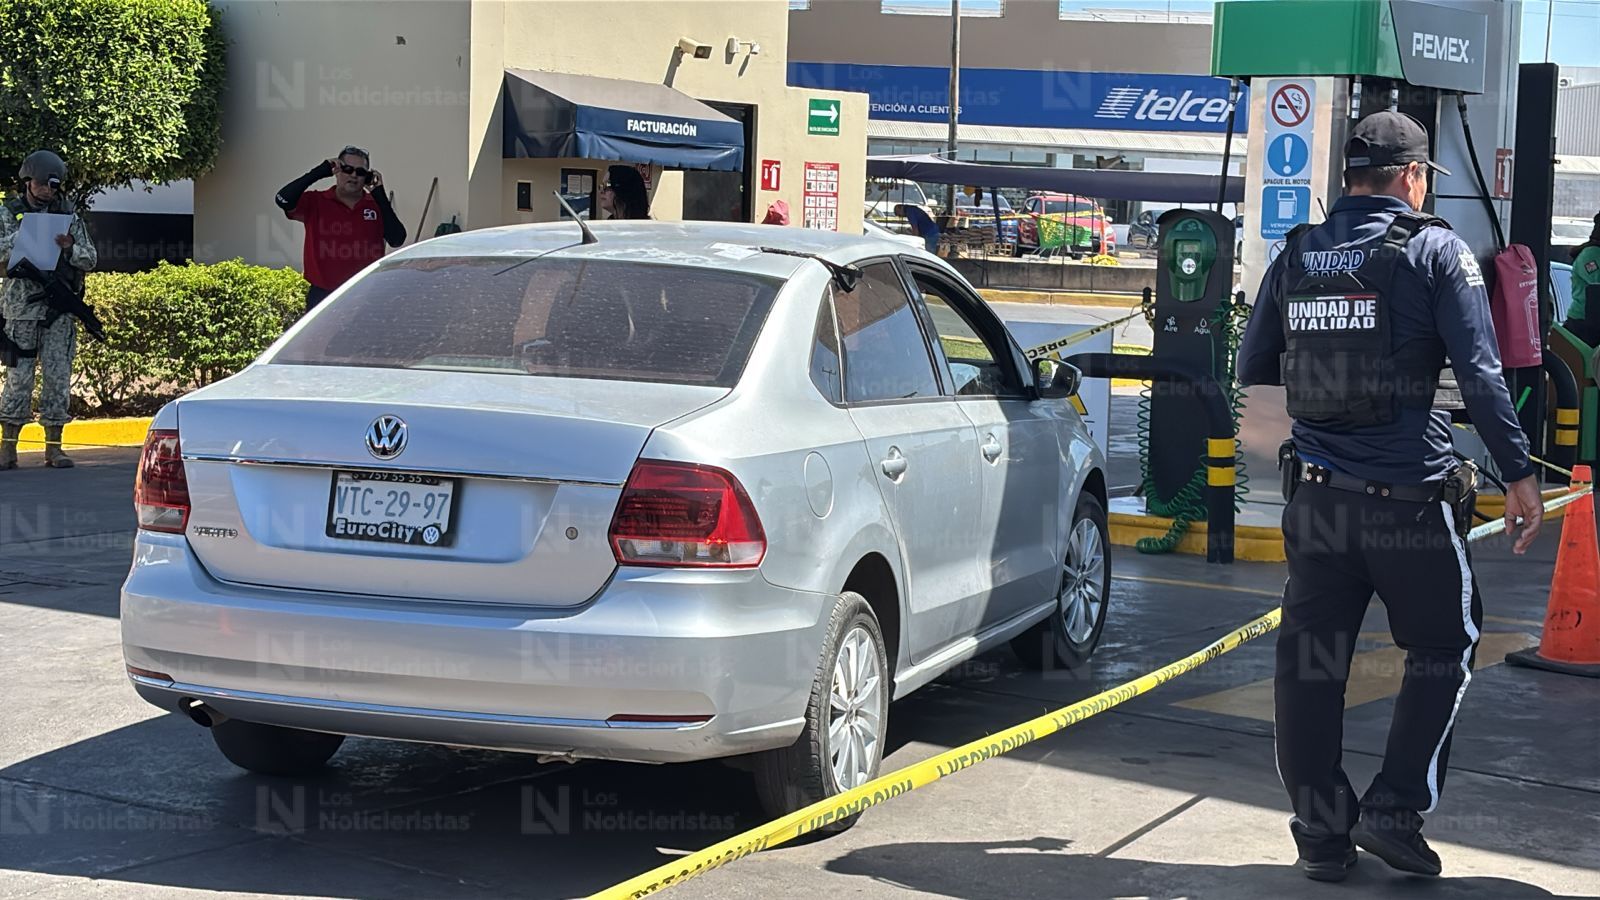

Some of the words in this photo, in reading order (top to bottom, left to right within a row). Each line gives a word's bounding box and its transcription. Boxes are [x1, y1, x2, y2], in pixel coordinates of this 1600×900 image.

[1412, 32, 1470, 63] PEMEX
[868, 103, 907, 113] TENCIÓN
[909, 105, 917, 113] A
[918, 105, 962, 114] CLIENTS
[1134, 89, 1243, 122] telcel
[627, 119, 697, 136] FACTURACIÓN
[1302, 250, 1364, 271] UNIDAD
[1288, 301, 1350, 318] UNIDAD
[1354, 300, 1376, 316] DE
[1288, 317, 1376, 331] VIALIDAD
[337, 485, 449, 520] VTC-29-97
[335, 518, 416, 543] EuroCity
